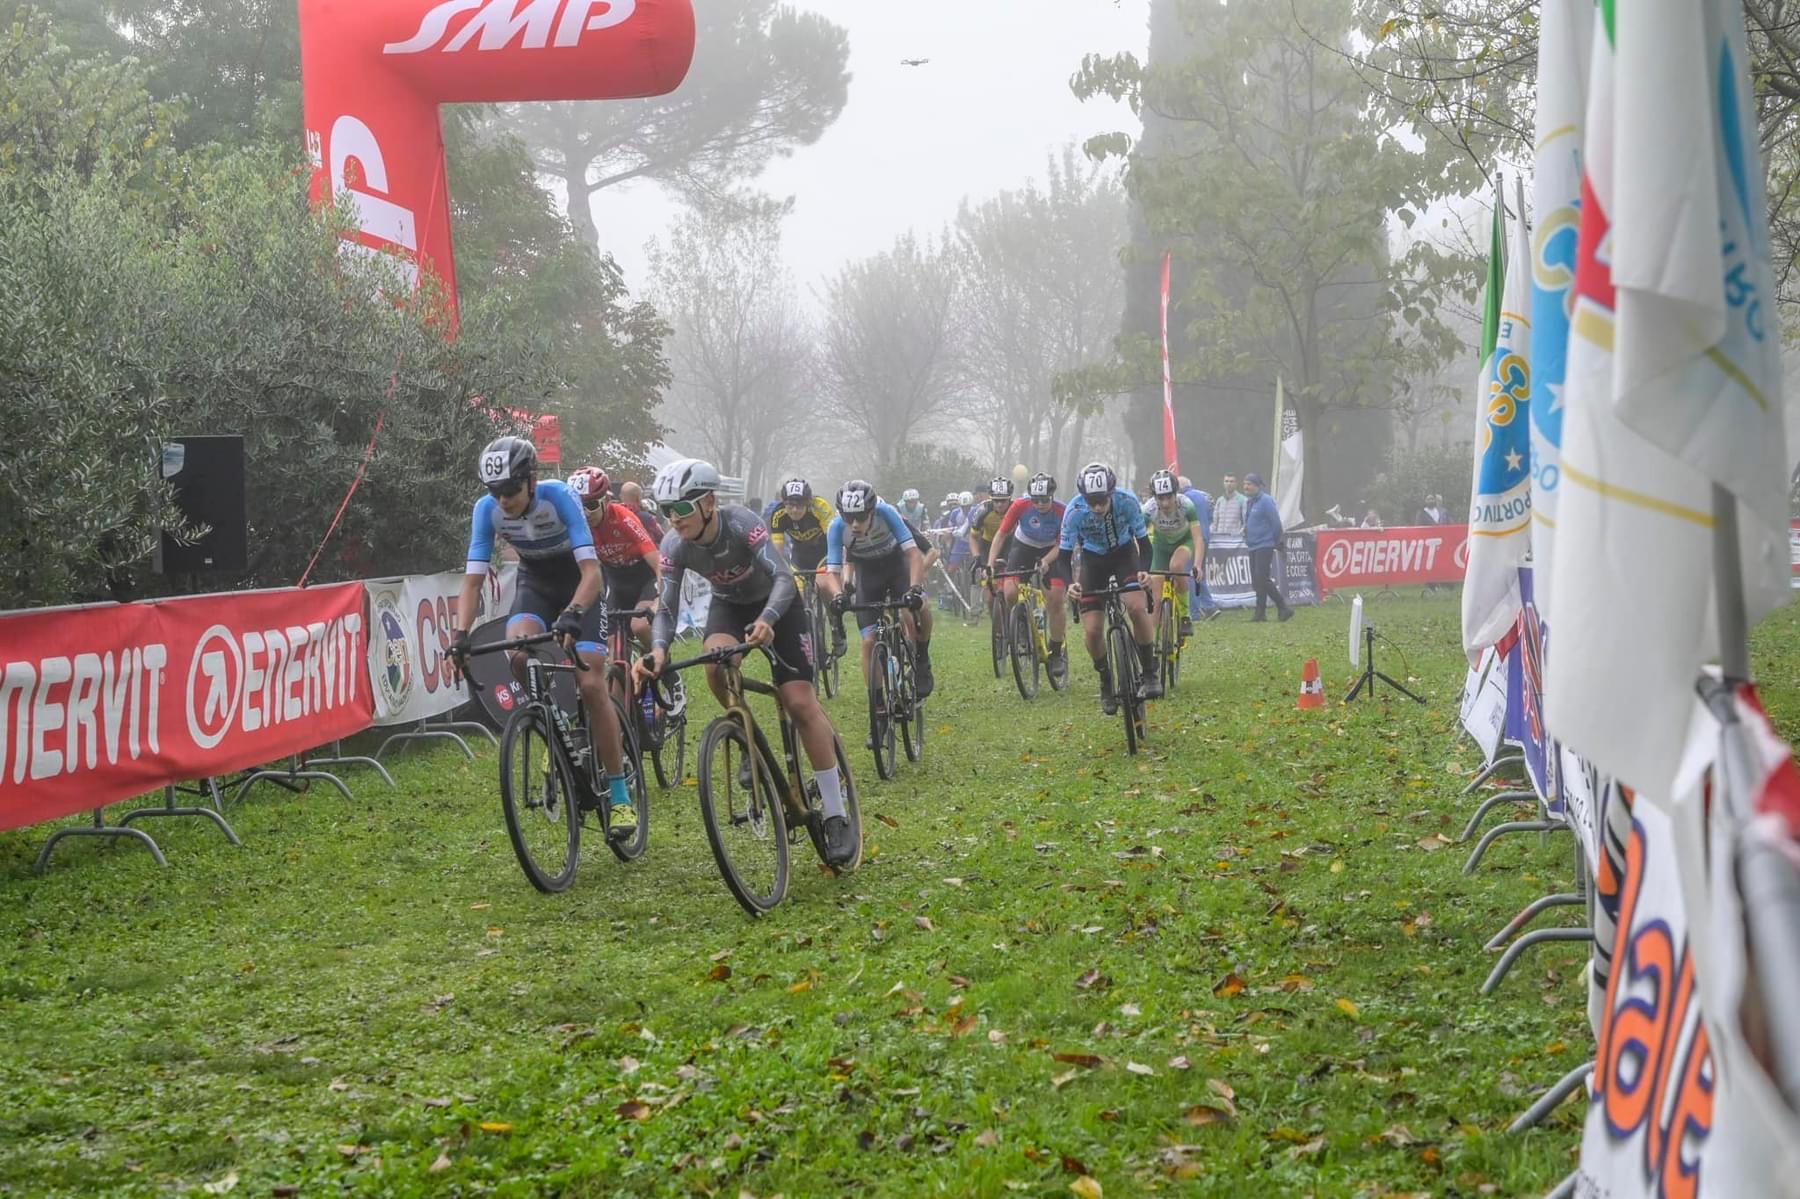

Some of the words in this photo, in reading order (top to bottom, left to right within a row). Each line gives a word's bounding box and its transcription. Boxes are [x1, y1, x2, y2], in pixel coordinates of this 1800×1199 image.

[382, 0, 637, 54] SMP
[485, 455, 503, 476] 69
[570, 477, 585, 491] 73
[658, 475, 674, 495] 71
[1088, 475, 1103, 489] 70
[1157, 480, 1169, 491] 74
[846, 494, 860, 508] 72
[1350, 538, 1442, 574] ENERVIT
[599, 601, 609, 641] CYCLING
[242, 613, 361, 732] ENERVIT
[497, 688, 511, 704] KS
[0, 644, 167, 785] NERVIT
